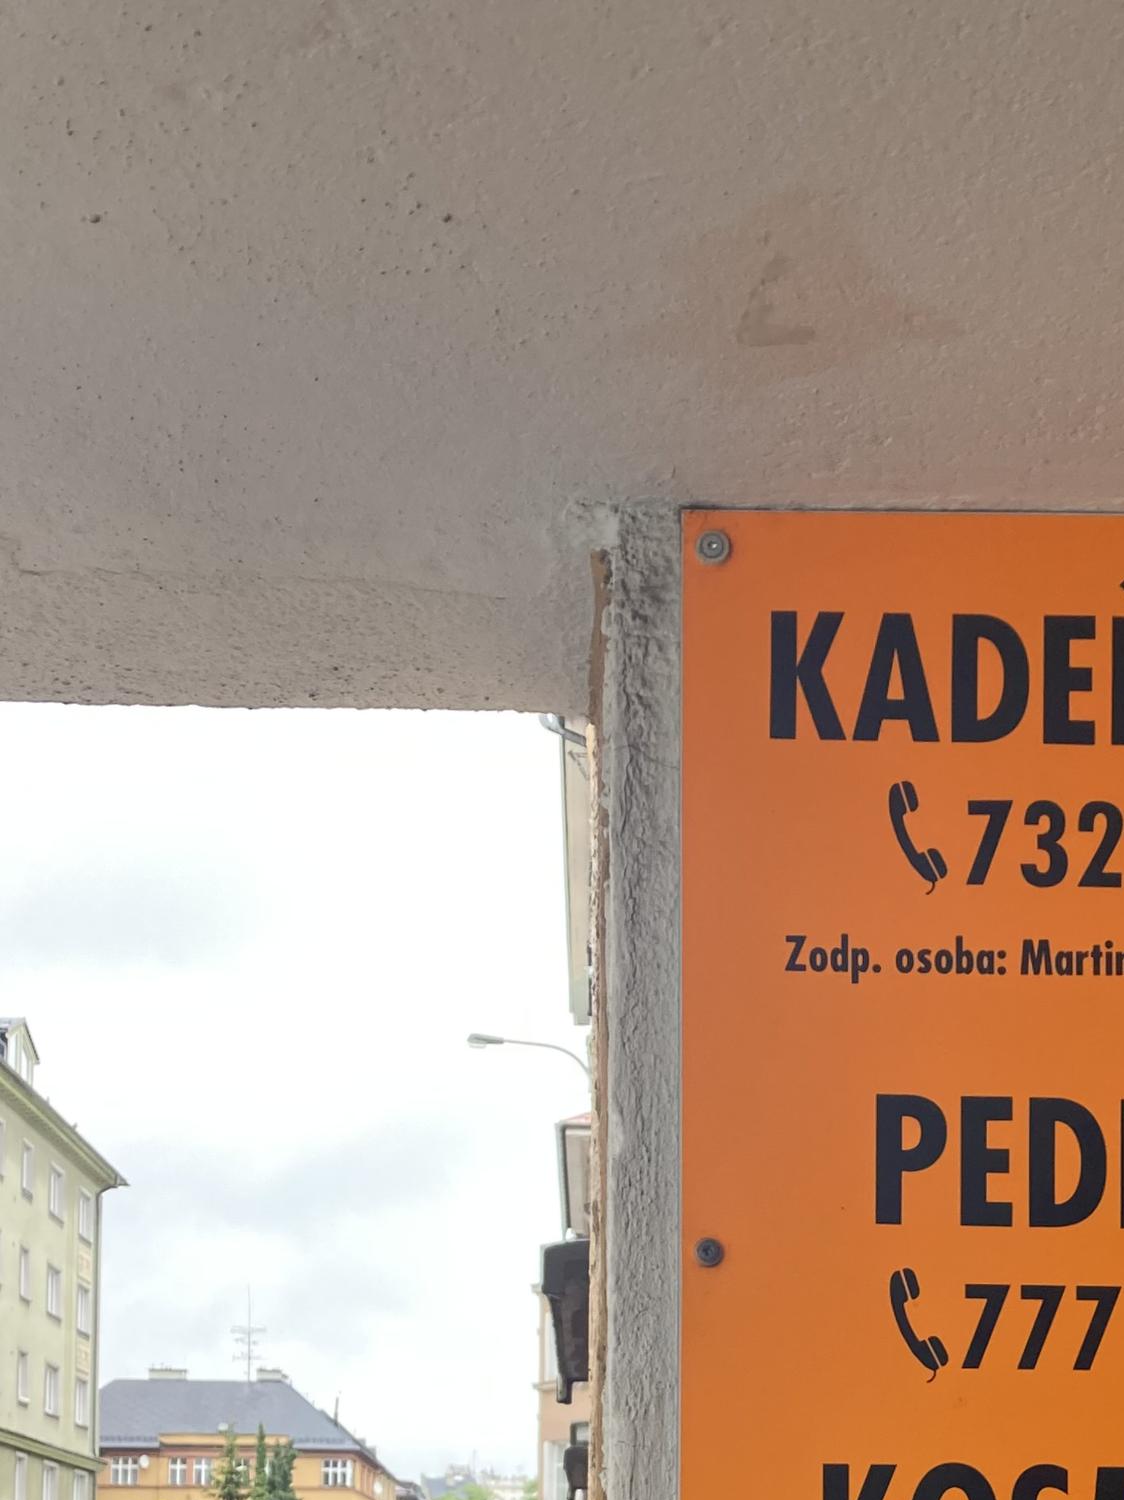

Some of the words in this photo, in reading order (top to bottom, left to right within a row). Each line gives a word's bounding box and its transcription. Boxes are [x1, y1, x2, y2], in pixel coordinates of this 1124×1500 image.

[965, 799, 1124, 888] 732
[784, 934, 882, 985] Zodp.
[895, 936, 1007, 977] osoba:
[961, 1283, 1122, 1370] 777
